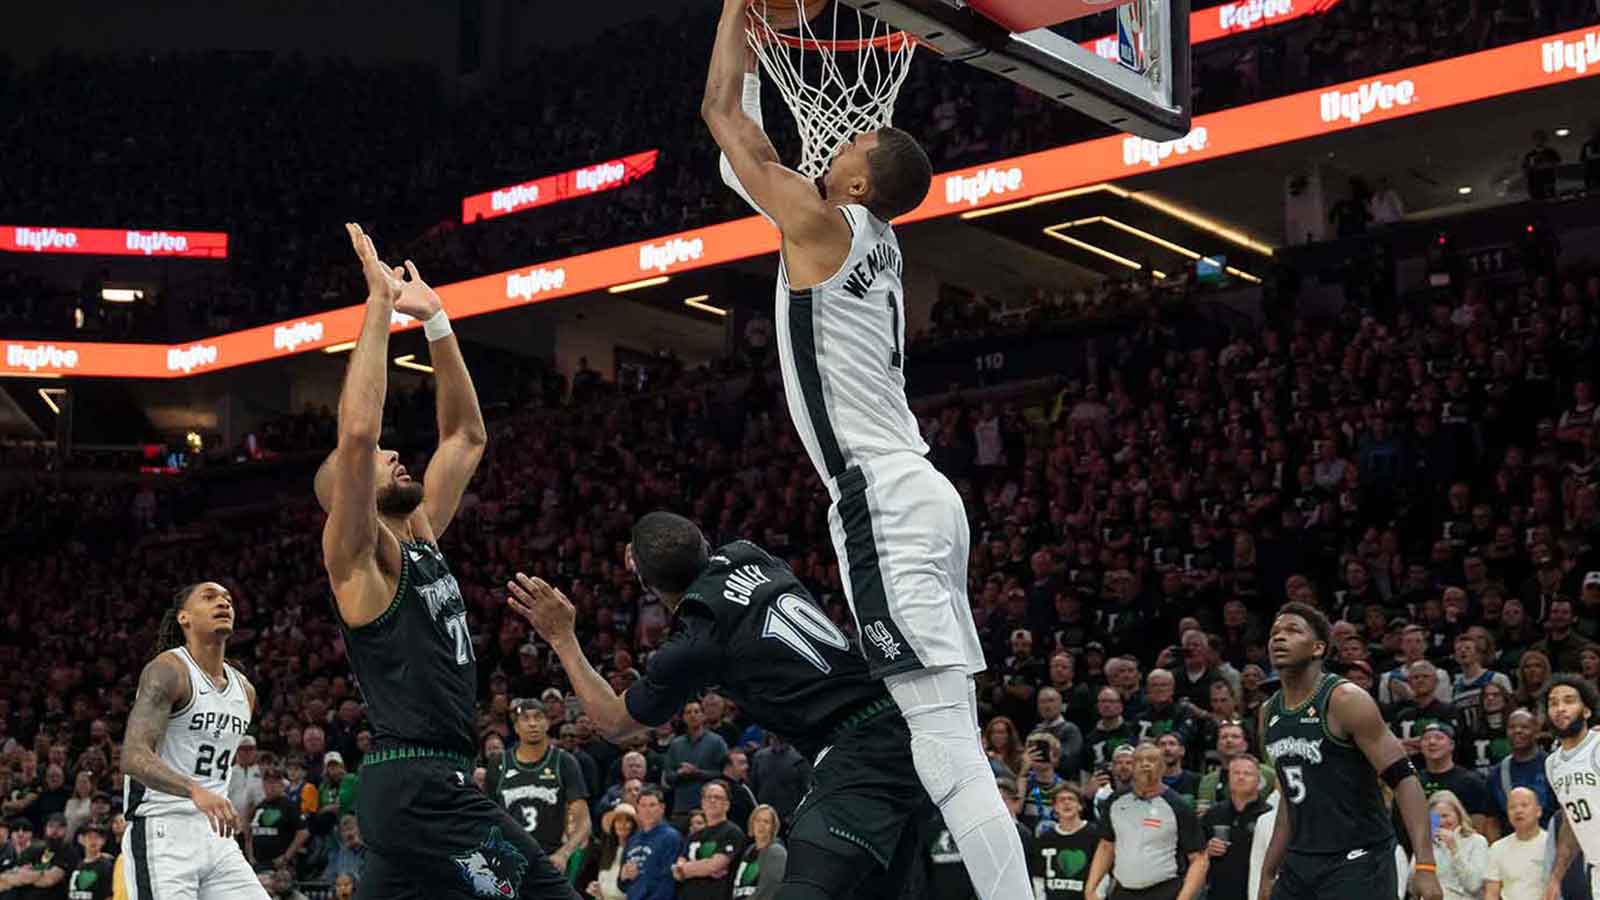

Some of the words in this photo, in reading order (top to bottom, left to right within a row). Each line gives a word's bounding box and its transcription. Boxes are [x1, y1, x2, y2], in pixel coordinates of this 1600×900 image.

[1542, 33, 1600, 73] HyV
[1320, 80, 1416, 122] HyVee
[576, 162, 625, 190] HyVee
[945, 168, 1023, 205] HyVee
[491, 185, 539, 212] HyVee
[16, 229, 77, 250] HyVee
[126, 232, 187, 254] HyVee
[640, 238, 704, 271] HyVee
[506, 268, 566, 300] HyVee
[273, 321, 325, 349] HyVee
[7, 345, 79, 370] HyVee
[167, 345, 217, 371] HyVee
[975, 352, 1005, 371] 110
[723, 564, 772, 606] CONLEY
[762, 593, 850, 674] 10
[194, 744, 232, 780] 24
[1281, 765, 1306, 804] 5
[521, 805, 538, 832] 3
[1565, 798, 1592, 823] 30
